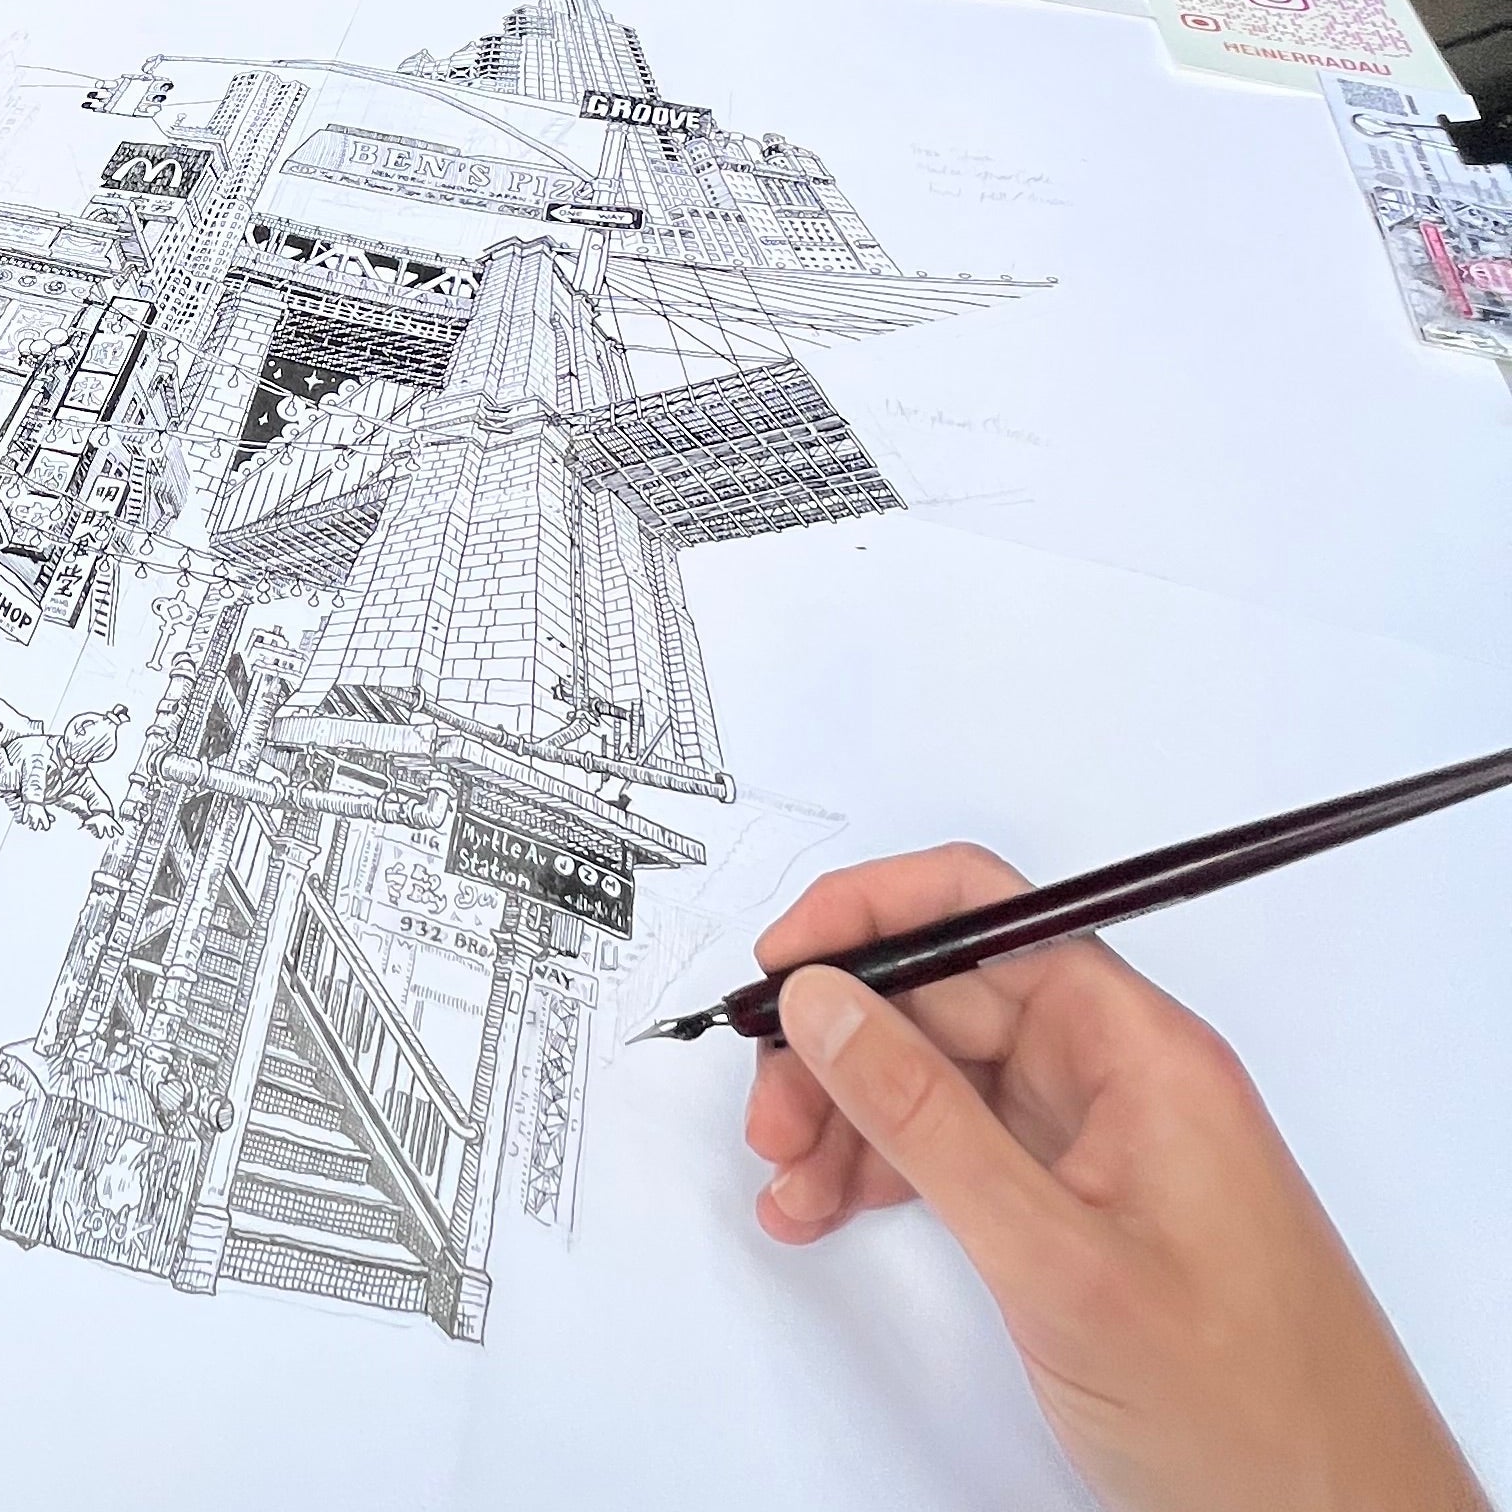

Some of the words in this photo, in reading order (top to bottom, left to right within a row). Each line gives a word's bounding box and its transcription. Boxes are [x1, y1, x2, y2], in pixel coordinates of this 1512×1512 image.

[1223, 40, 1393, 76] HEINERRADAU
[586, 94, 702, 130] GROOVE
[350, 140, 491, 188] BEN'S
[558, 208, 583, 218] ONE
[598, 212, 625, 222] WAY
[462, 822, 522, 859] Myrtle
[524, 845, 547, 866] Av
[458, 847, 532, 891] Station
[399, 916, 444, 944] 932
